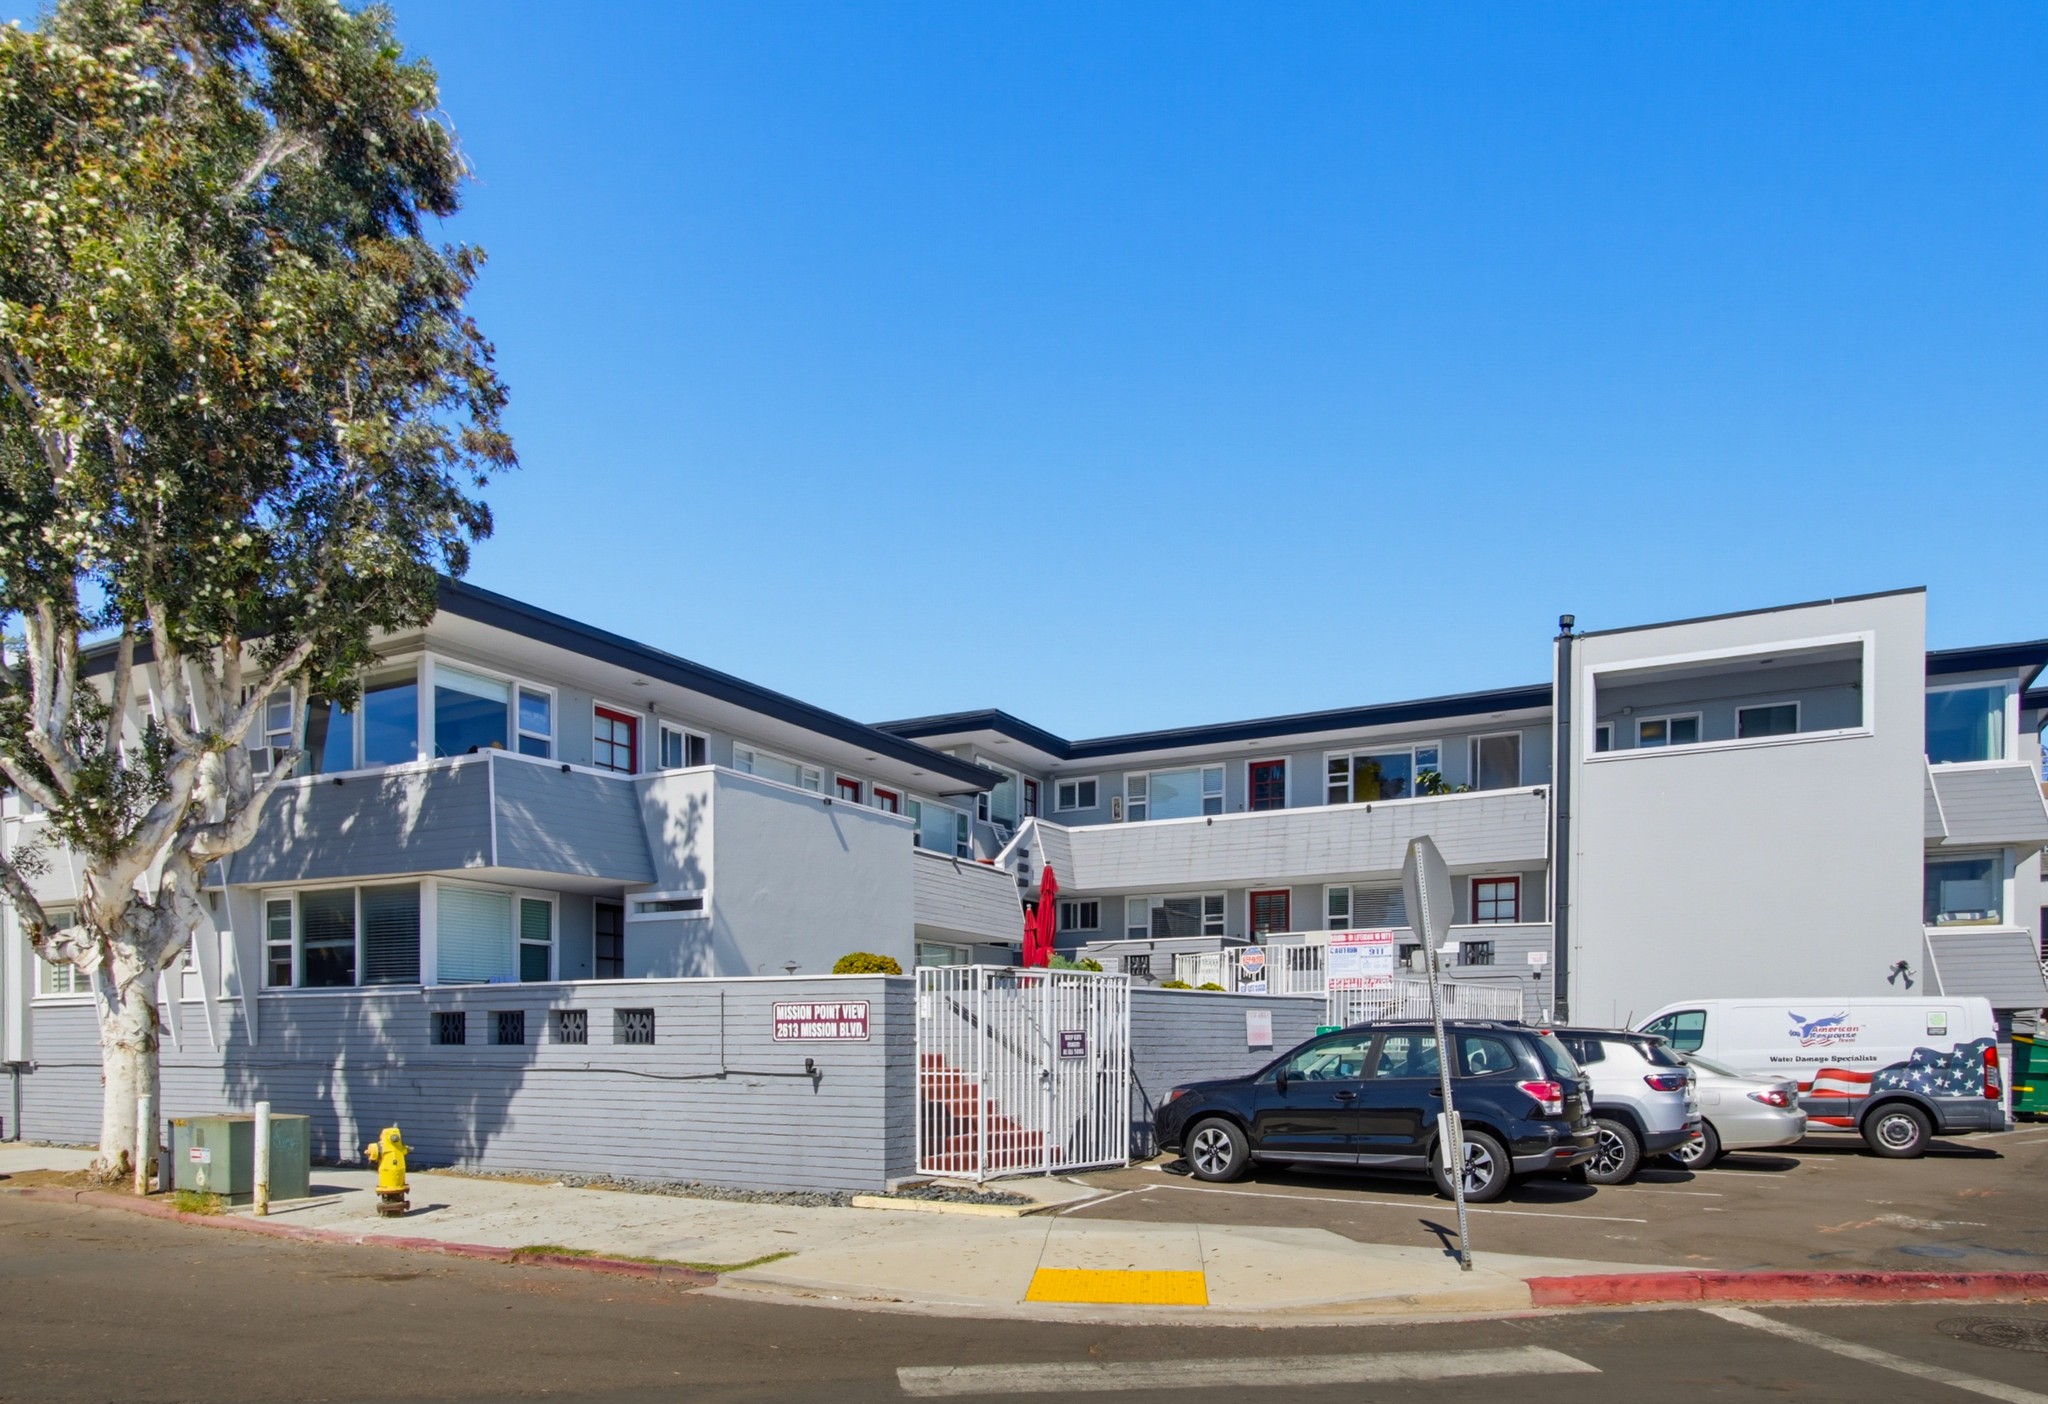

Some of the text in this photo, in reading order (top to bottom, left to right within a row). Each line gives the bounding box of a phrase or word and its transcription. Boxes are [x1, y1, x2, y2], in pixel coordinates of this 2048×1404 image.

[1330, 947, 1357, 955] CAUTION
[776, 1004, 866, 1020] MISSION POINT VIEW
[777, 1021, 866, 1037] 2613 MISSION BLVD.
[1795, 1055, 1829, 1063] Damage
[1831, 1055, 1877, 1063] Specialists
